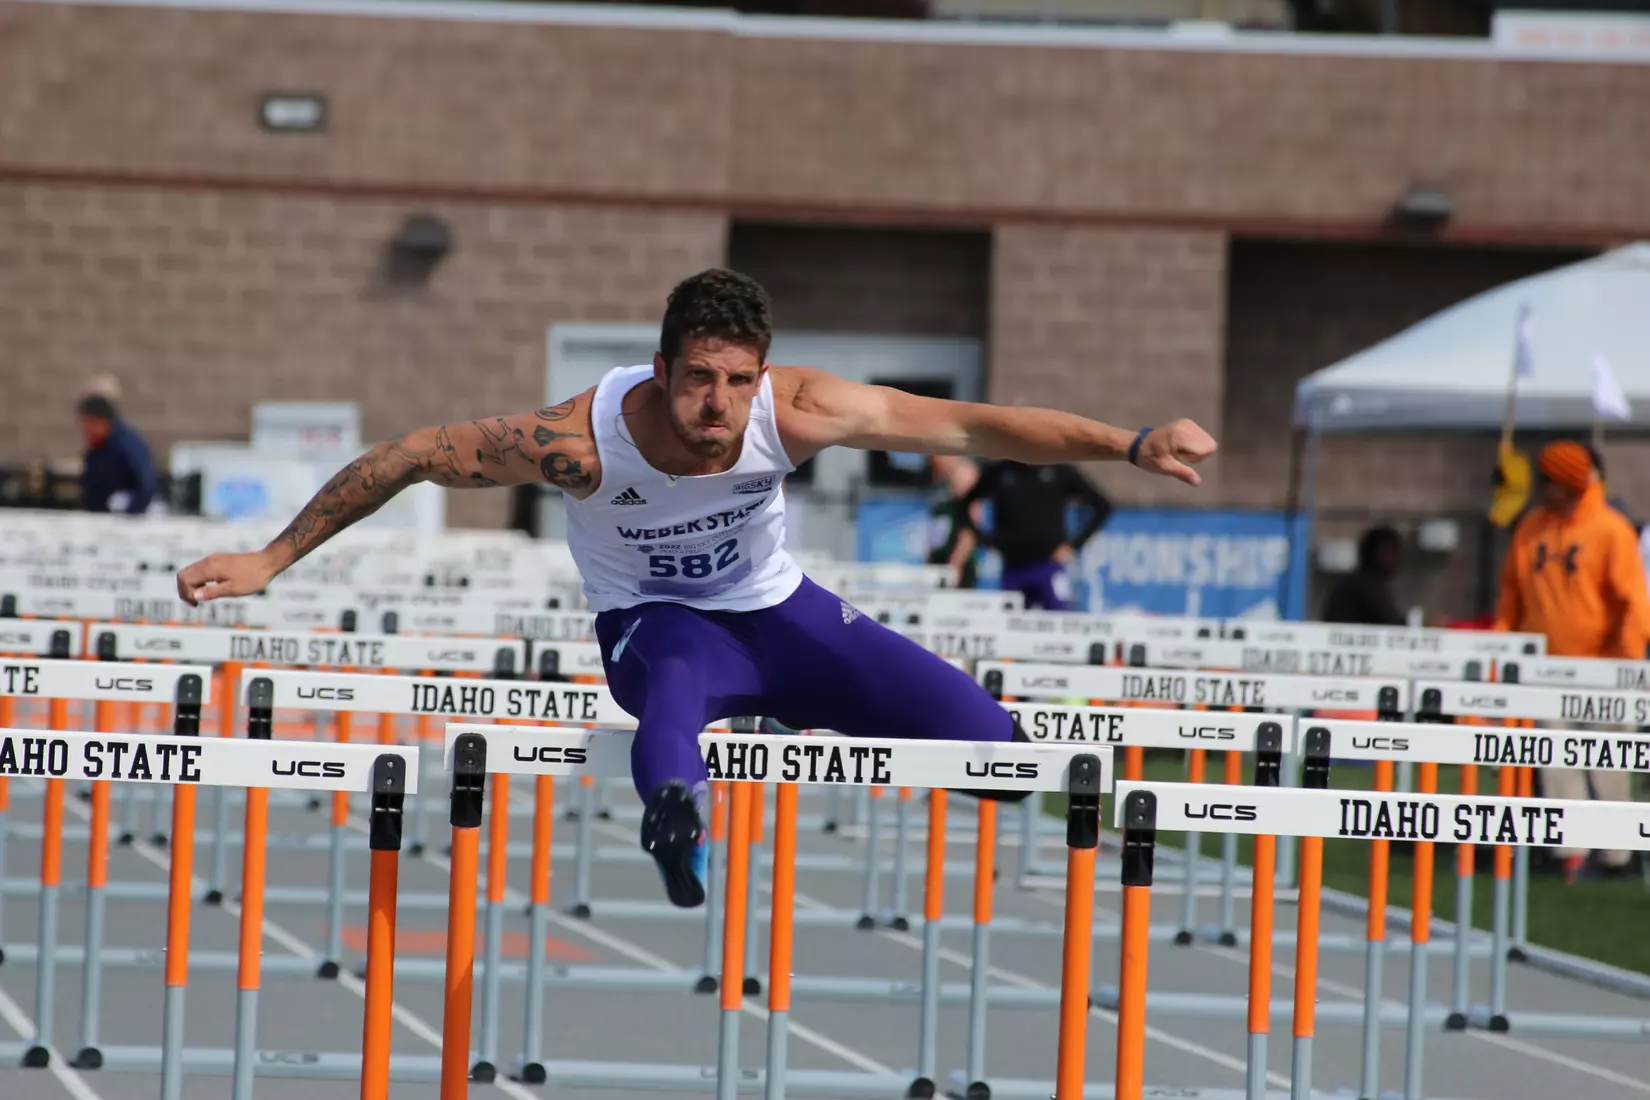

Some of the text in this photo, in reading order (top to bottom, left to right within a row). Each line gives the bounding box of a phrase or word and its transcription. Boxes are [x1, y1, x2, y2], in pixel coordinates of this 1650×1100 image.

[611, 498, 647, 506] adidas
[706, 497, 768, 530] STA
[650, 538, 739, 578] 582
[135, 637, 182, 651] UCS
[230, 635, 384, 666] IDAHO STATE
[95, 677, 153, 691] UCS
[1022, 676, 1068, 689] UCS
[1122, 674, 1266, 706] IDAHO STATE
[297, 686, 355, 701] UCS
[411, 683, 599, 720] IDAHO STATE
[1312, 689, 1360, 701] UCS
[1459, 694, 1508, 708] UCS
[1560, 694, 1626, 722] IDAHO
[1033, 710, 1124, 742] STATE
[1179, 726, 1235, 741] UCS
[1352, 736, 1410, 751] UCS
[1473, 733, 1650, 769] IDAHO STATE
[83, 740, 202, 781] STATE
[513, 746, 588, 764] UCS
[782, 745, 892, 784] STATE
[272, 759, 346, 778] UCS
[965, 761, 1039, 779] UCS
[1184, 802, 1257, 821] UCS
[1339, 798, 1564, 845] IDAHO STATE
[701, 1066, 759, 1080] US
